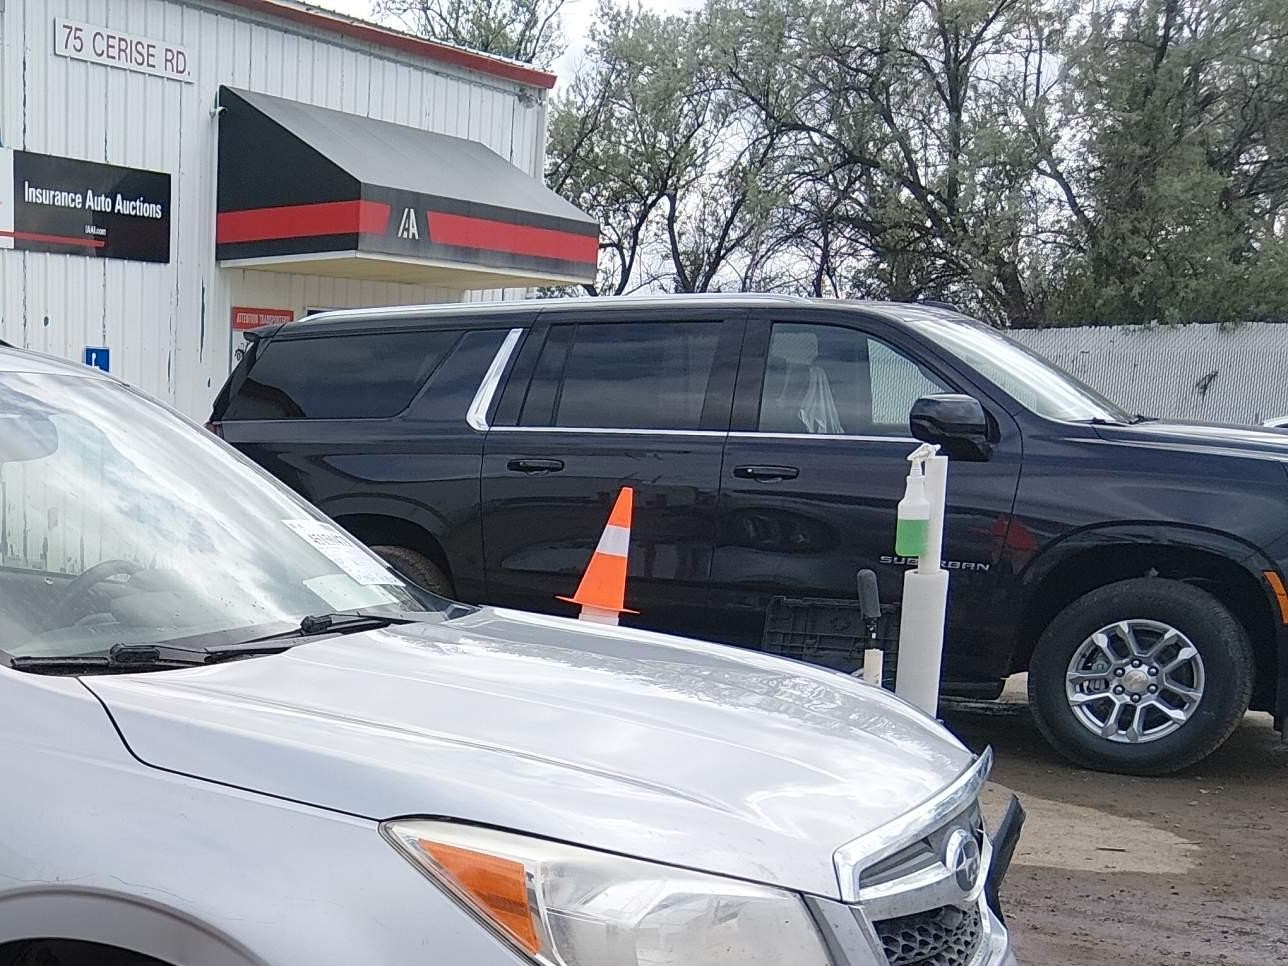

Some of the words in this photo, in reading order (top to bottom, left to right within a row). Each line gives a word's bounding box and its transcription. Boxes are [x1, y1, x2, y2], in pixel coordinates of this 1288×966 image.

[62, 24, 84, 53] 75
[92, 31, 157, 69] CERISE
[164, 47, 191, 77] RD.
[24, 180, 83, 209] Insurance
[85, 189, 112, 213] Auto
[114, 193, 163, 220] Auctions
[879, 554, 990, 571] SUBRBAN
